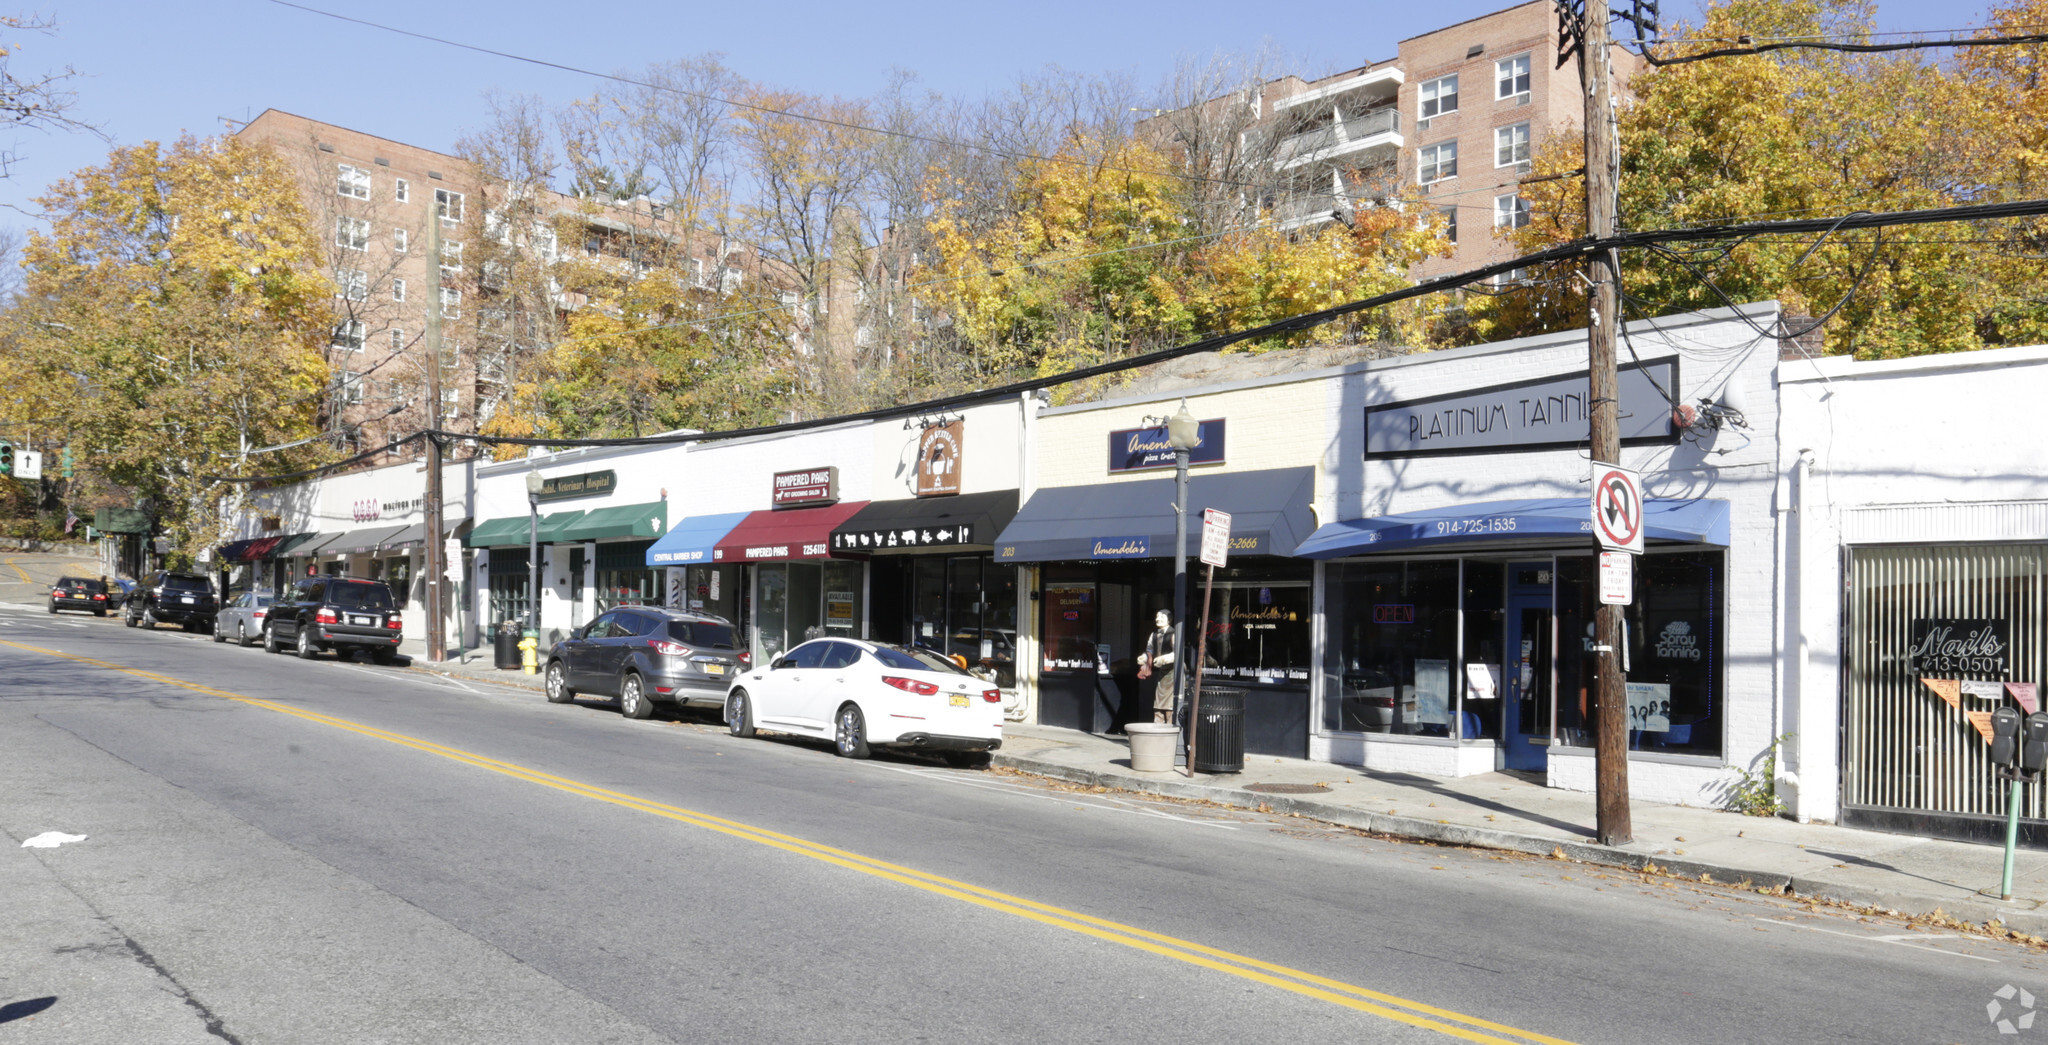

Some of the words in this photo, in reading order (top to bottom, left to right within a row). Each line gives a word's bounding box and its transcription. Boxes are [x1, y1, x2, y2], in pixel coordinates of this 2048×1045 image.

[1409, 403, 1509, 441] PLATINUM
[1520, 391, 1590, 427] TANNI
[558, 481, 585, 492] Veterinary
[587, 475, 610, 490] Hospital
[776, 473, 810, 487] PAMPERED
[811, 471, 829, 484] PAWS
[1437, 517, 1516, 534] 914-725-1535
[1580, 521, 1592, 530] 20
[1227, 537, 1257, 549] 2-2666
[1369, 533, 1382, 542] 205
[714, 549, 723, 559] 199
[746, 547, 772, 558] PAMPERED
[773, 546, 788, 556] PAWS
[1002, 546, 1015, 557] 203
[1094, 539, 1146, 556] Amendola's
[654, 553, 673, 561] CENTRAL
[673, 552, 690, 560] BARBER
[691, 551, 703, 560] SHOP
[1231, 605, 1289, 619] Amendola's
[1375, 606, 1413, 622] OPEN
[1660, 631, 1696, 649] Spray
[1910, 626, 2003, 657] Nails
[1655, 644, 1701, 662] Tanning
[1922, 657, 2003, 671] 713-0501
[1222, 666, 1236, 678] Soups
[1240, 667, 1254, 677] Whole
[1255, 667, 1270, 677] Wheat
[1270, 669, 1285, 678] Pasta
[1289, 670, 1308, 680] Entrees
